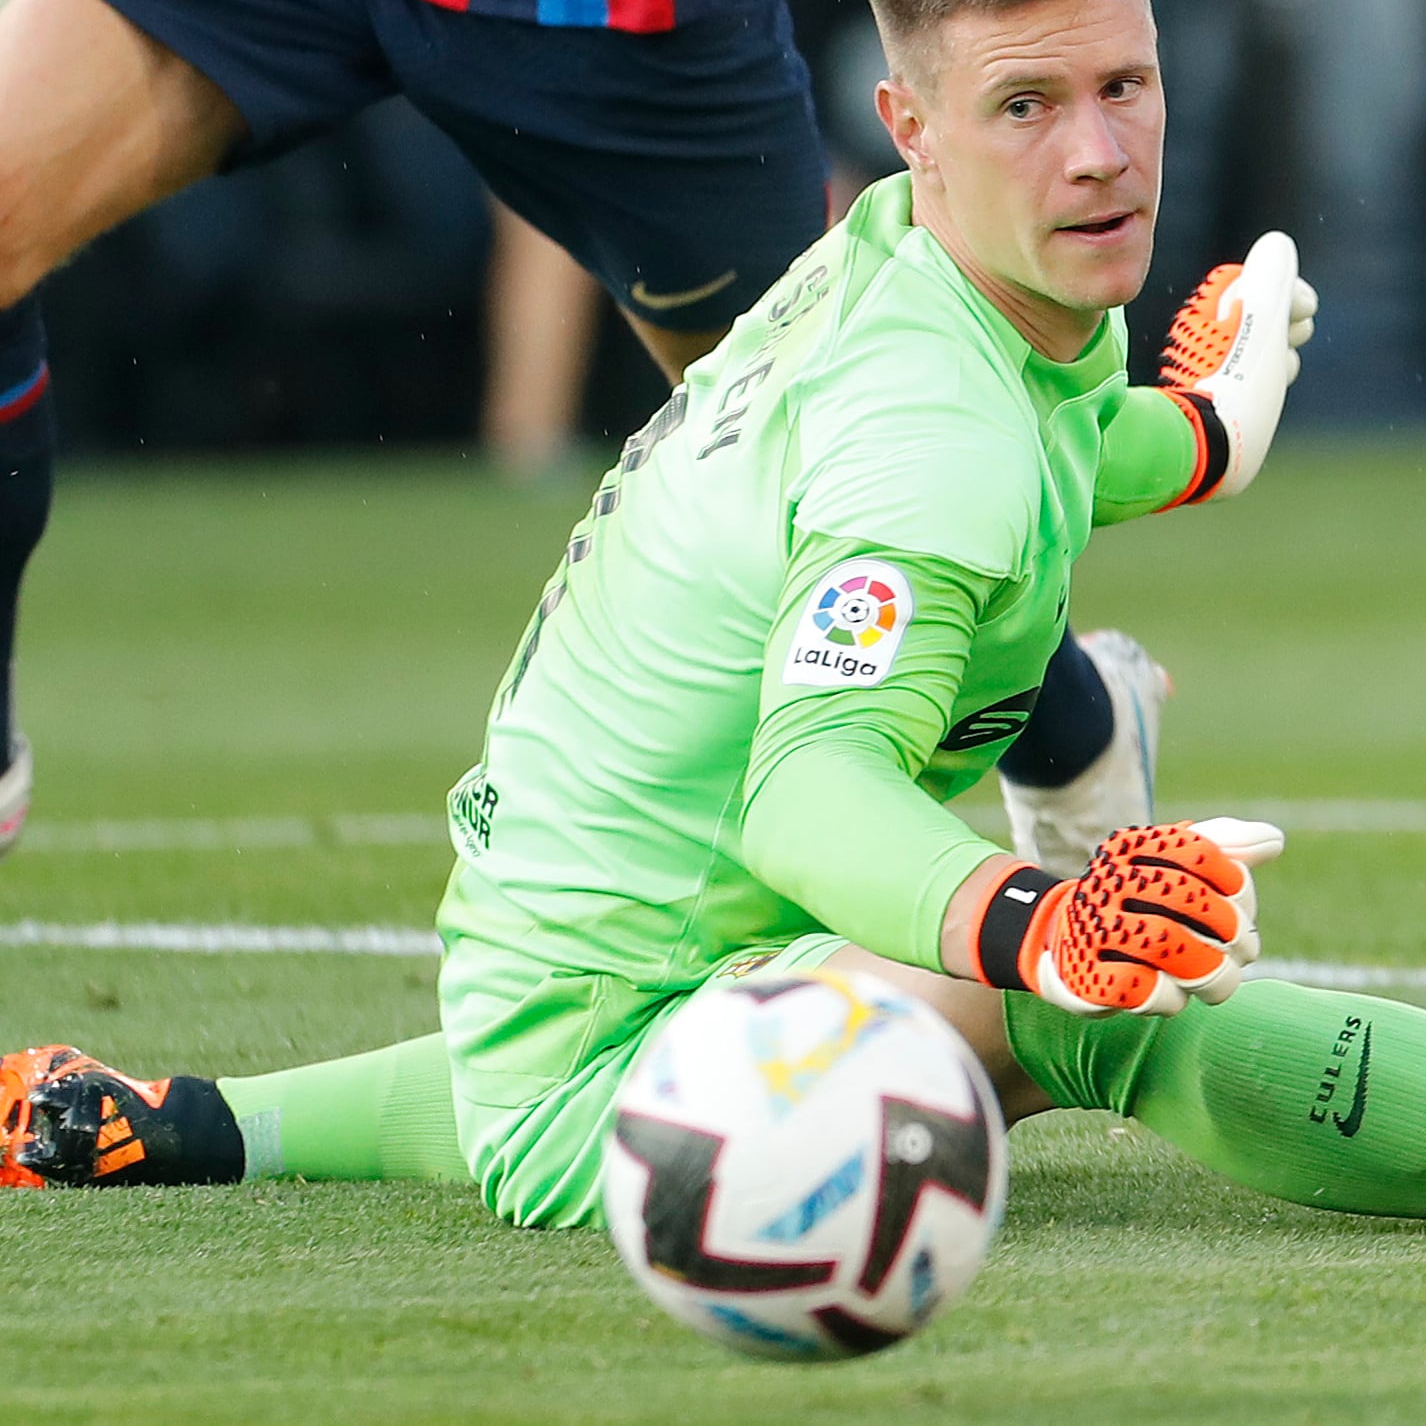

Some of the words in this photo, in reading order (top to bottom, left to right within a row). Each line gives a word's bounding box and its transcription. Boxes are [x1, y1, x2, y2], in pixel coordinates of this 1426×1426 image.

[793, 646, 878, 677] LaLiga
[1003, 886, 1038, 905] 1
[1308, 1015, 1362, 1124] CULERS
